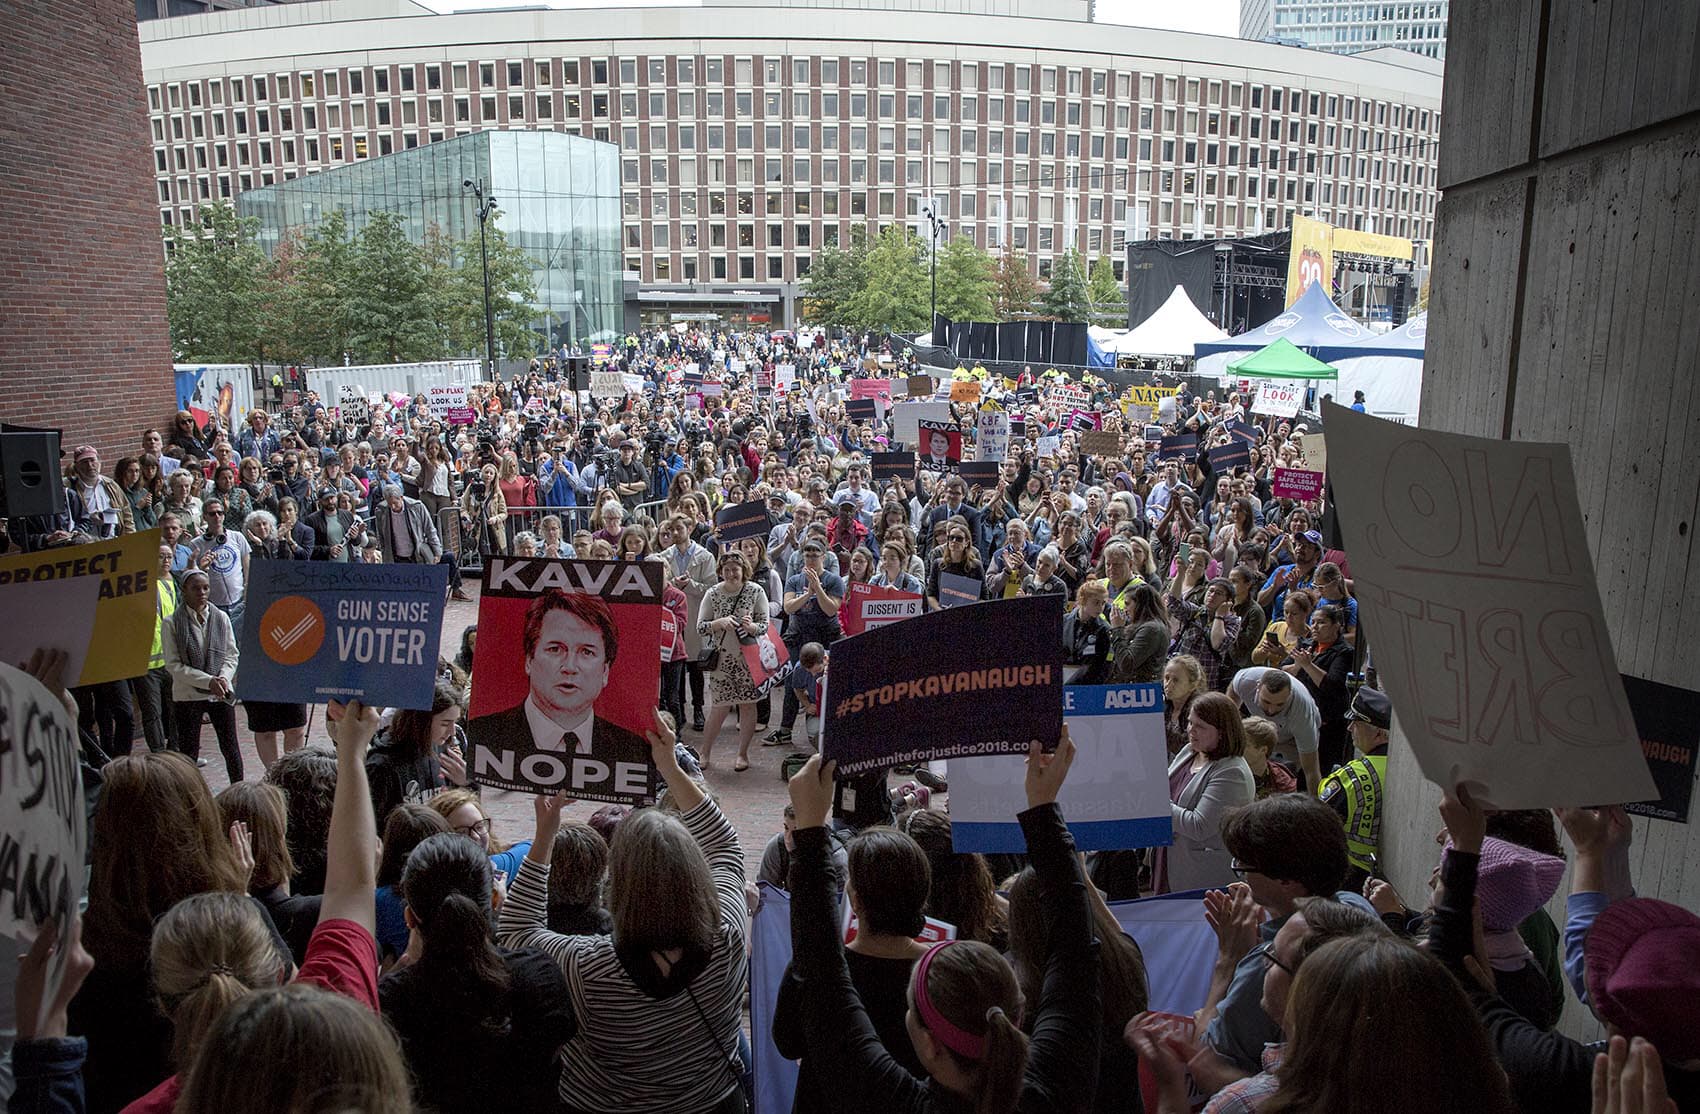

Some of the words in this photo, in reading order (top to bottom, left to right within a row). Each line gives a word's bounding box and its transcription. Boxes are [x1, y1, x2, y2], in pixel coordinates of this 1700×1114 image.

[430, 397, 450, 405] LOOK
[1262, 389, 1295, 402] LOOK
[920, 420, 961, 433] KAVA
[981, 415, 1000, 426] CBF
[921, 460, 960, 475] NOPE
[1283, 471, 1314, 480] PROTECT
[1280, 482, 1315, 492] ABORTION
[1297, 478, 1319, 487] LEGAL
[98, 569, 149, 601] ARE
[270, 566, 433, 590] #StopKavanaugh
[489, 559, 655, 597] KAVA
[852, 584, 872, 595] ACLU
[337, 599, 373, 621] GUN
[376, 601, 430, 623] SENSE
[867, 603, 904, 615] DISSENT
[906, 602, 916, 615] IS
[336, 625, 427, 666] VOTER
[834, 664, 1052, 719] #STOPKAVANAUGH
[1104, 687, 1156, 709] ACLU
[839, 741, 1031, 777] www.uniteforjustice2018.co
[474, 743, 649, 795] NOPE
[1359, 774, 1373, 829] BOSTON
